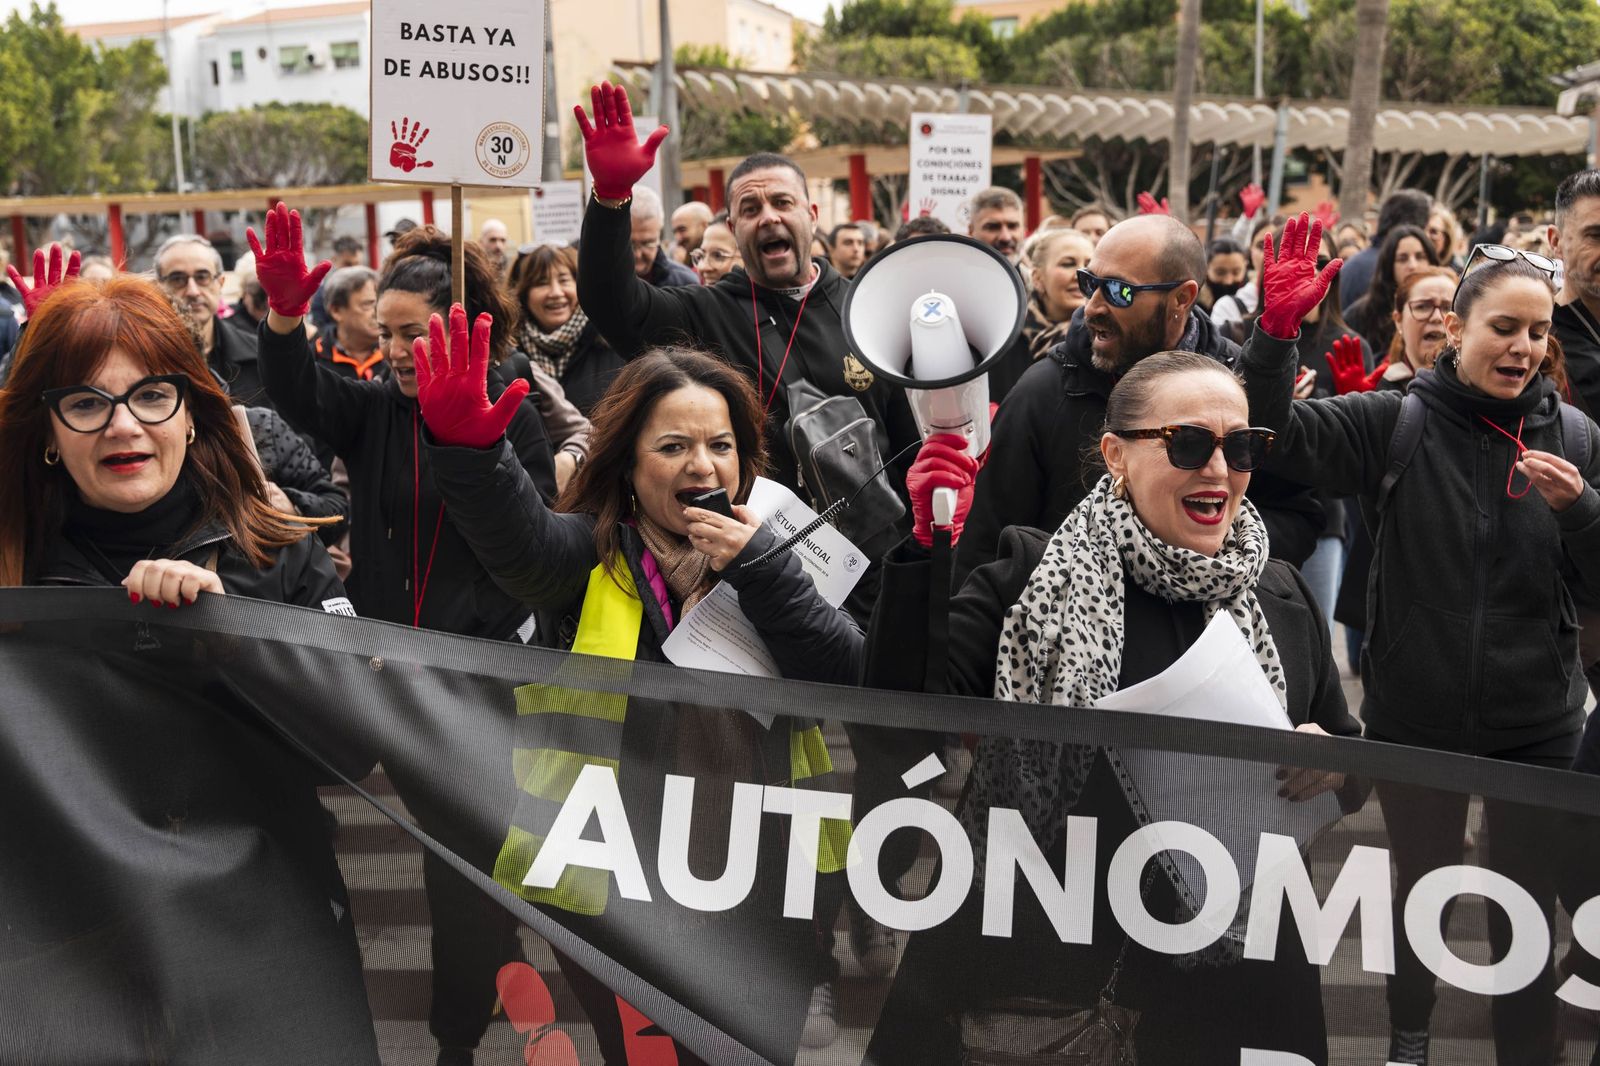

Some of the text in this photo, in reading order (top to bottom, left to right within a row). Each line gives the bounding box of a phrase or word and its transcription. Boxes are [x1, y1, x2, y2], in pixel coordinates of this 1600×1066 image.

[400, 22, 516, 47] BASTA YA
[384, 58, 530, 84] DE ABUSOS!!
[491, 136, 514, 154] 30
[928, 146, 971, 154] POR UNA
[497, 154, 505, 165] N
[917, 160, 982, 169] CONDICIONES
[922, 173, 979, 183] DE TRABAJO
[931, 187, 967, 196] DIGNAS
[774, 509, 798, 536] LECTUR
[800, 537, 831, 564] INICIAL
[849, 556, 857, 566] 30
